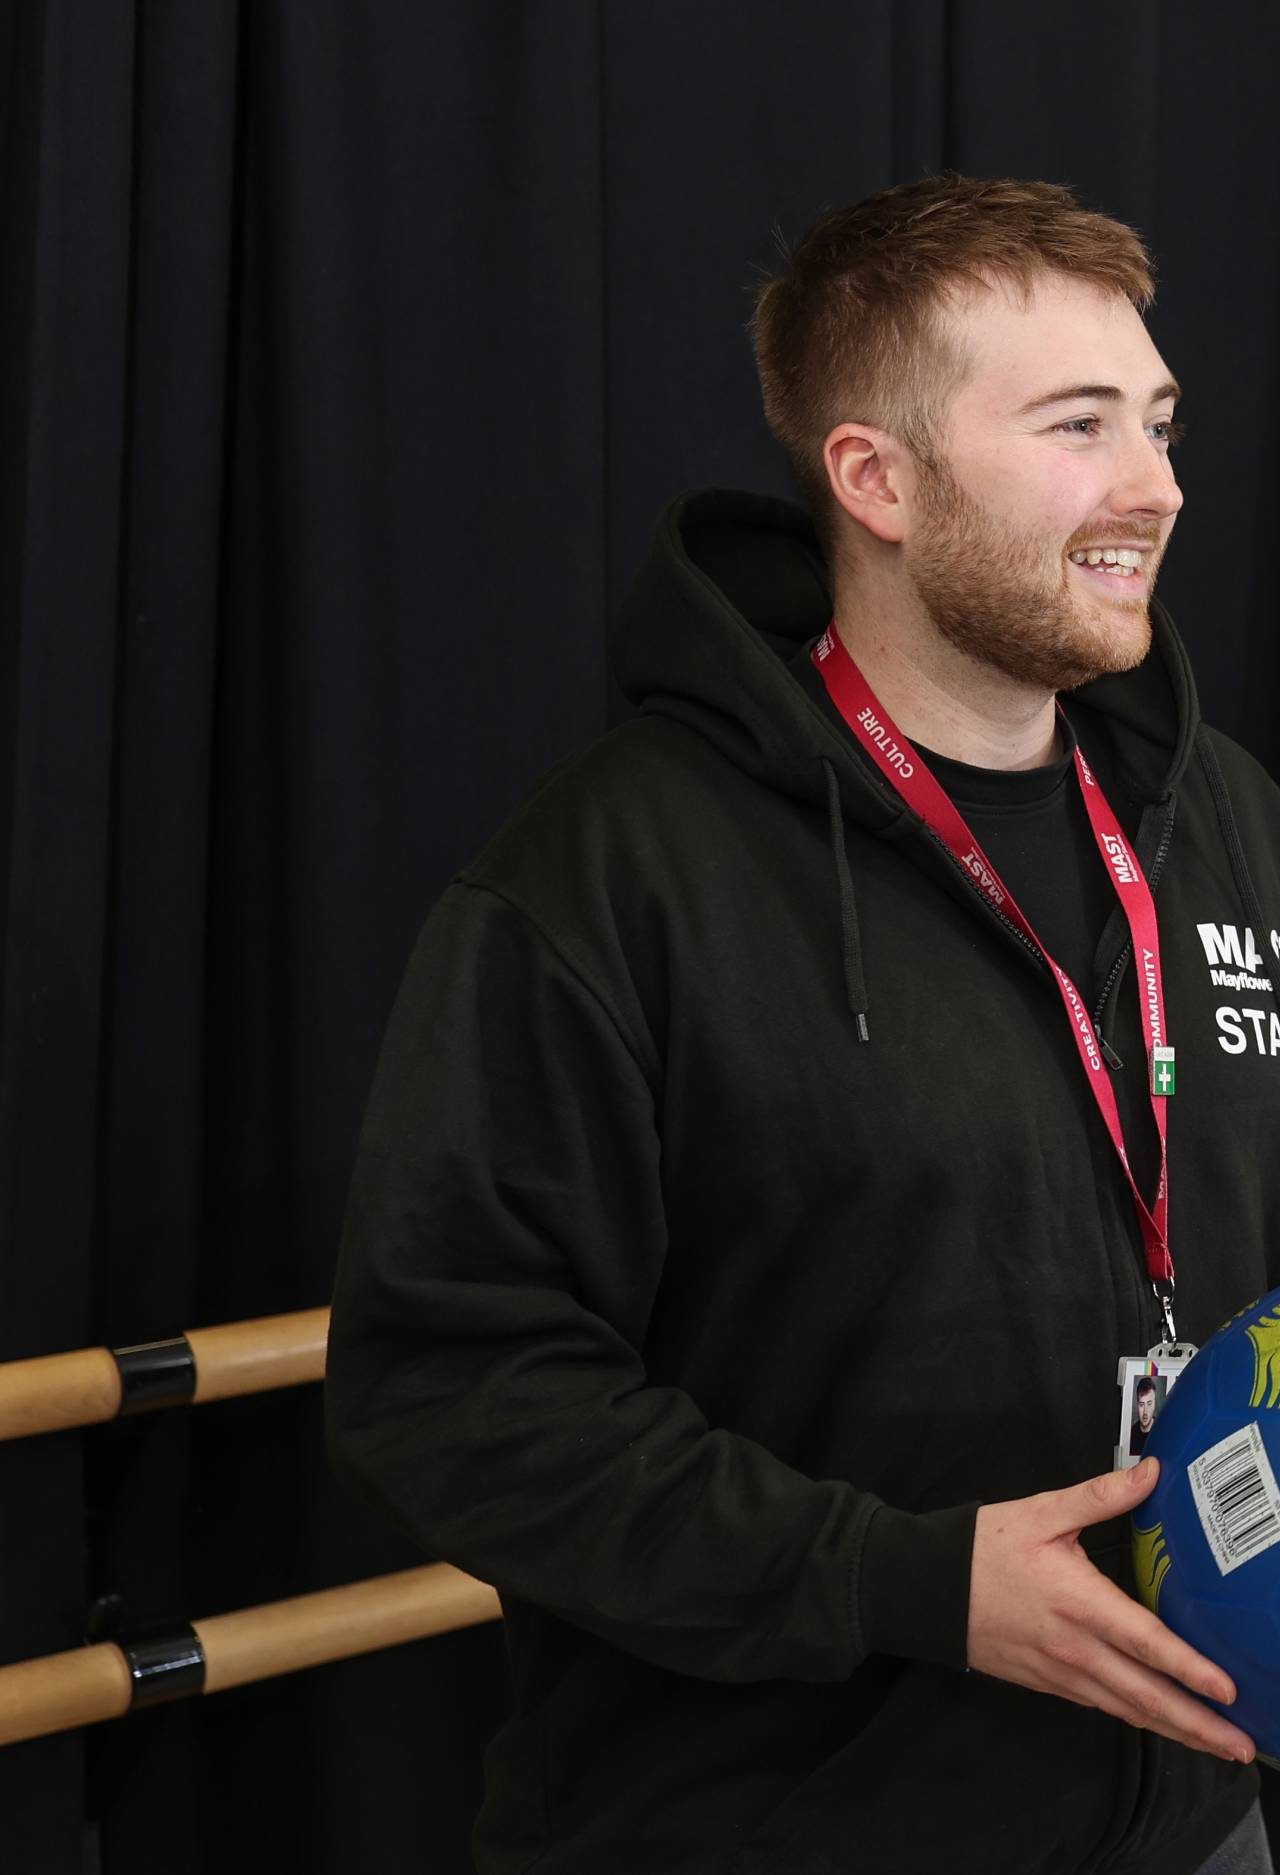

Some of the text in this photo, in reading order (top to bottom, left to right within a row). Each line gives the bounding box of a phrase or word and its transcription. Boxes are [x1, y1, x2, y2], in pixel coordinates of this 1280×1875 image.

[856, 707, 914, 779] CULTURE
[961, 852, 1004, 905] MAST
[1100, 832, 1133, 883] MAST
[1143, 948, 1163, 1048] OMMUNITY
[1209, 969, 1274, 992] Mayflowe
[1055, 966, 1100, 1071] CREATIVITY
